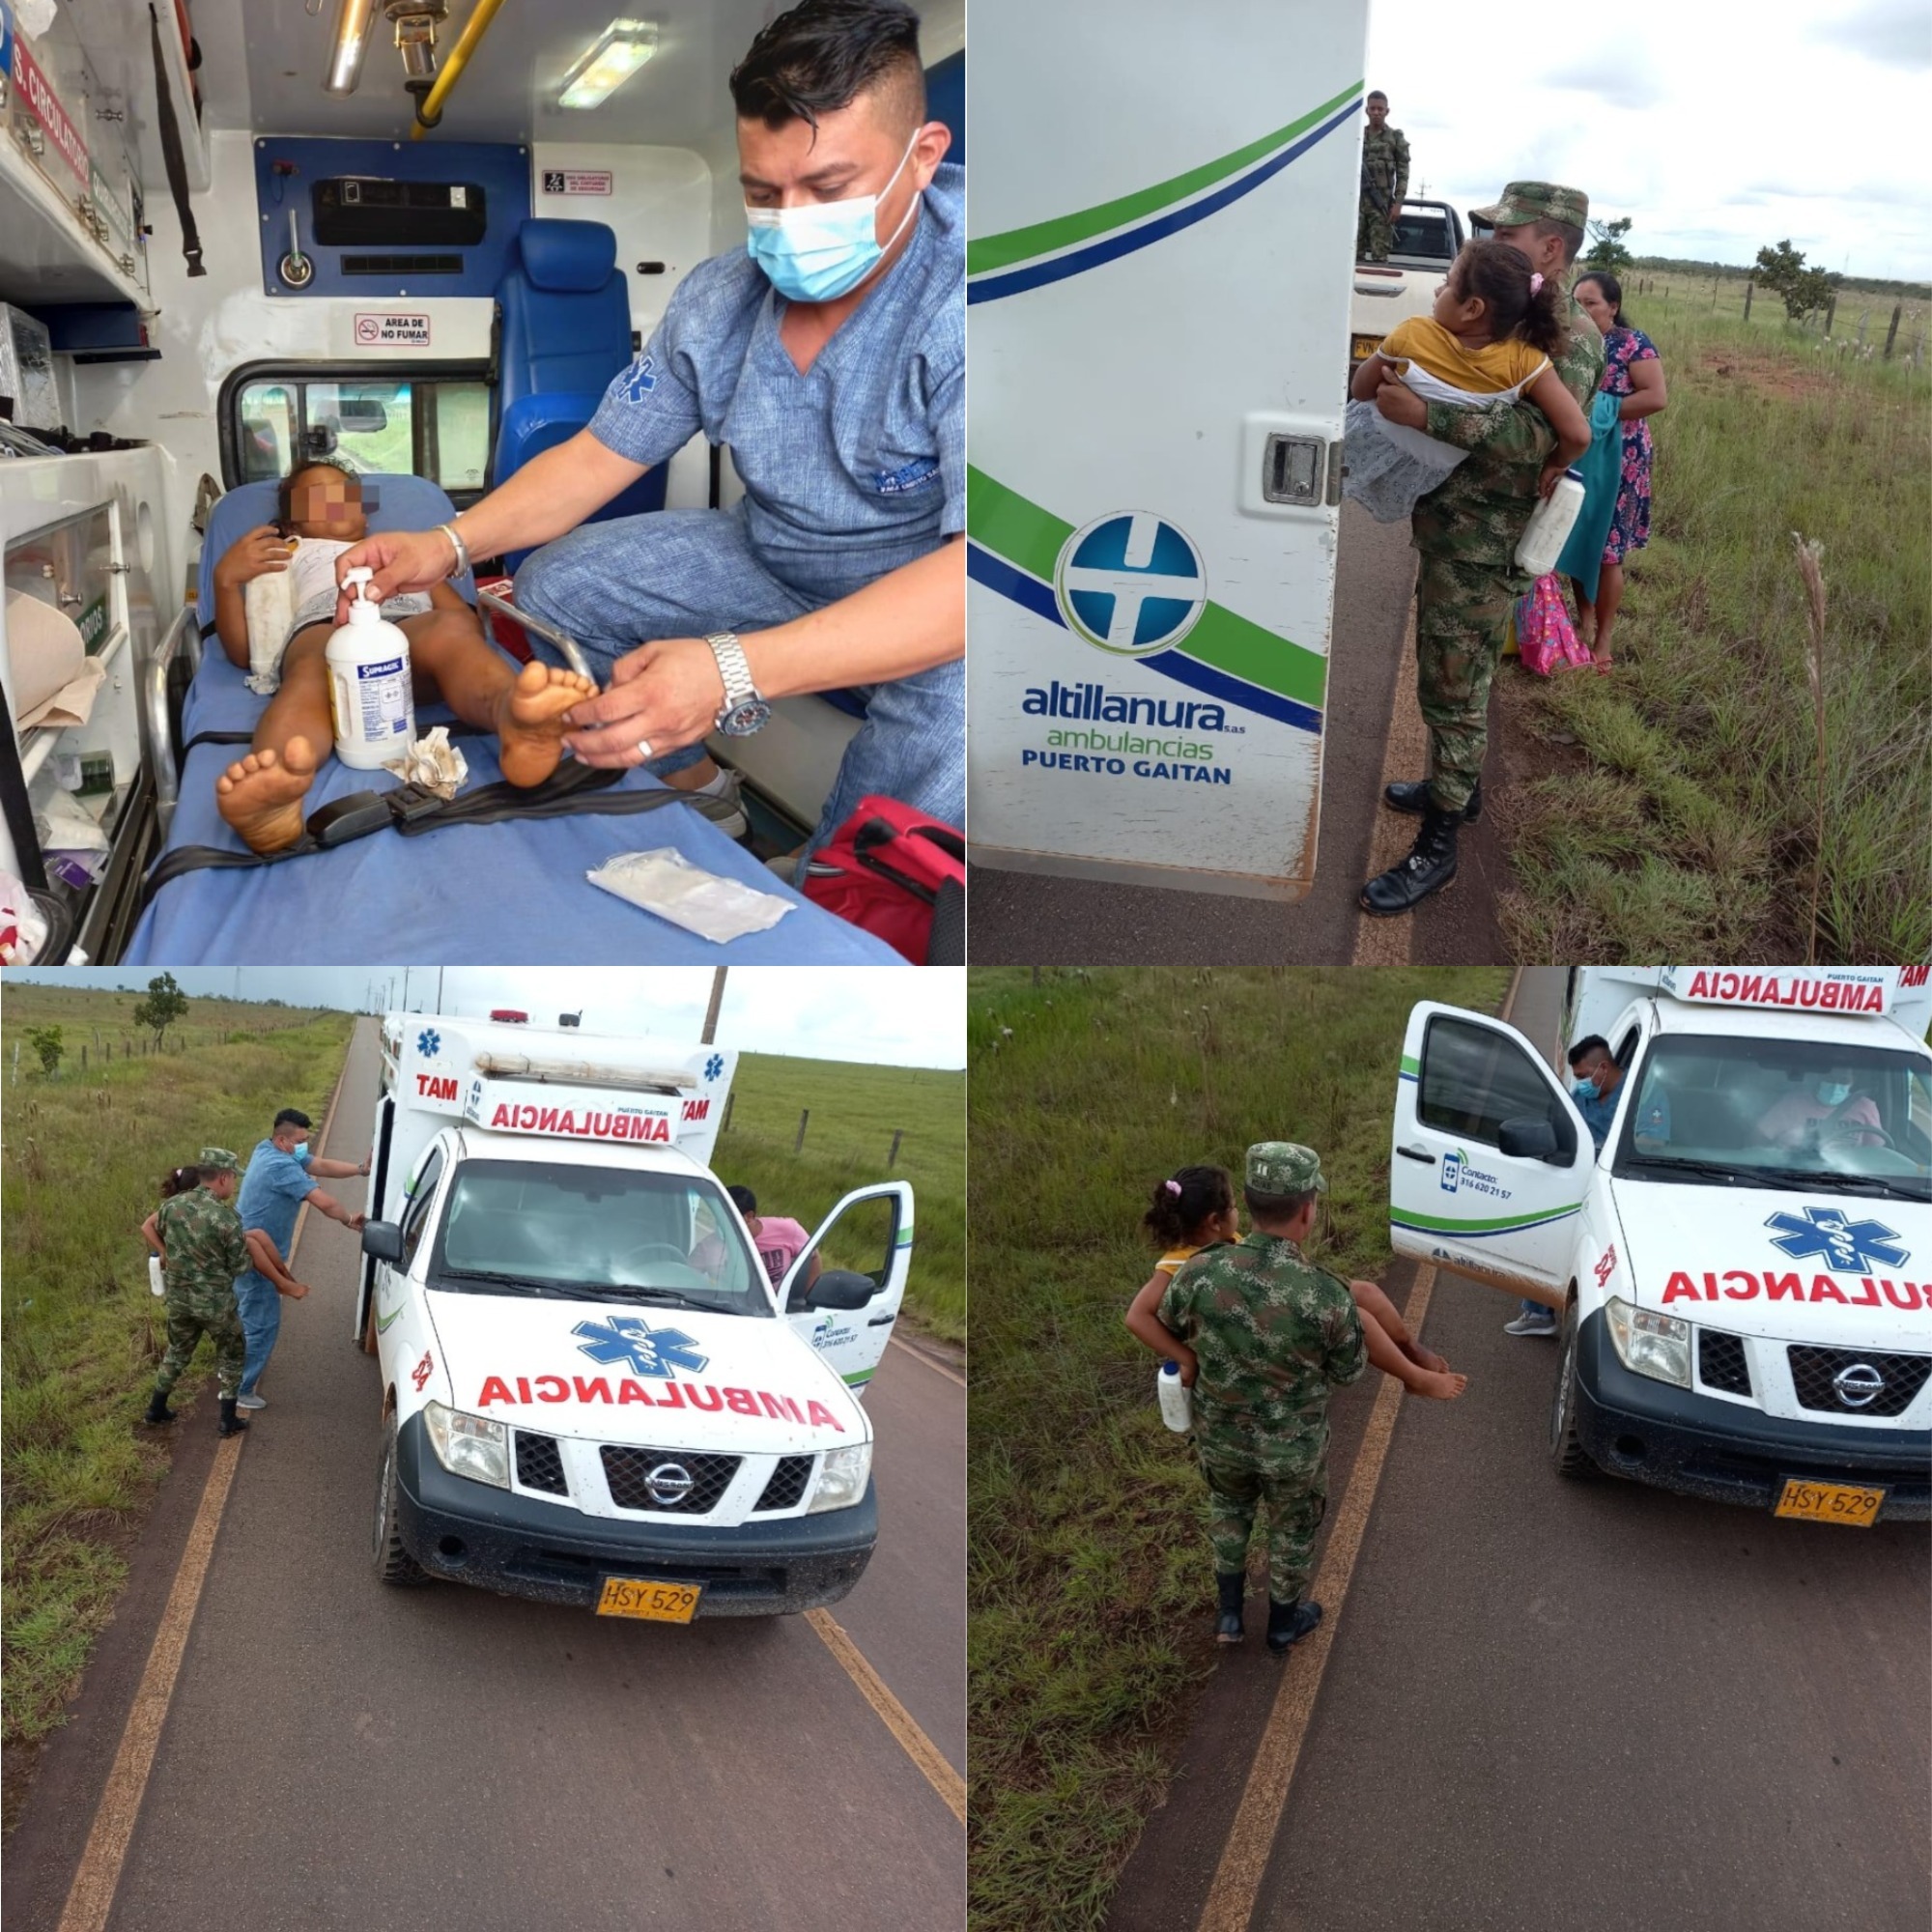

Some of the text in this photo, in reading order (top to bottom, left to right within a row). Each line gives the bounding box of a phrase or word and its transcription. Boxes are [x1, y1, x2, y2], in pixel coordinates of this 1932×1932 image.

[14, 43, 27, 91] S.
[382, 330, 428, 339] NO FUMAR
[385, 318, 423, 327] AREA DE
[1022, 680, 1225, 732] altillanura
[1047, 728, 1213, 760] ambulancias
[1022, 750, 1232, 784] PUERTO GAITAN
[1827, 973, 1856, 981] PUERTO
[416, 1073, 459, 1101] TAM
[1461, 1177, 1513, 1200] 316 620 21 57
[1783, 1488, 1877, 1516] HSY 529
[604, 1585, 695, 1612] HSY 529
